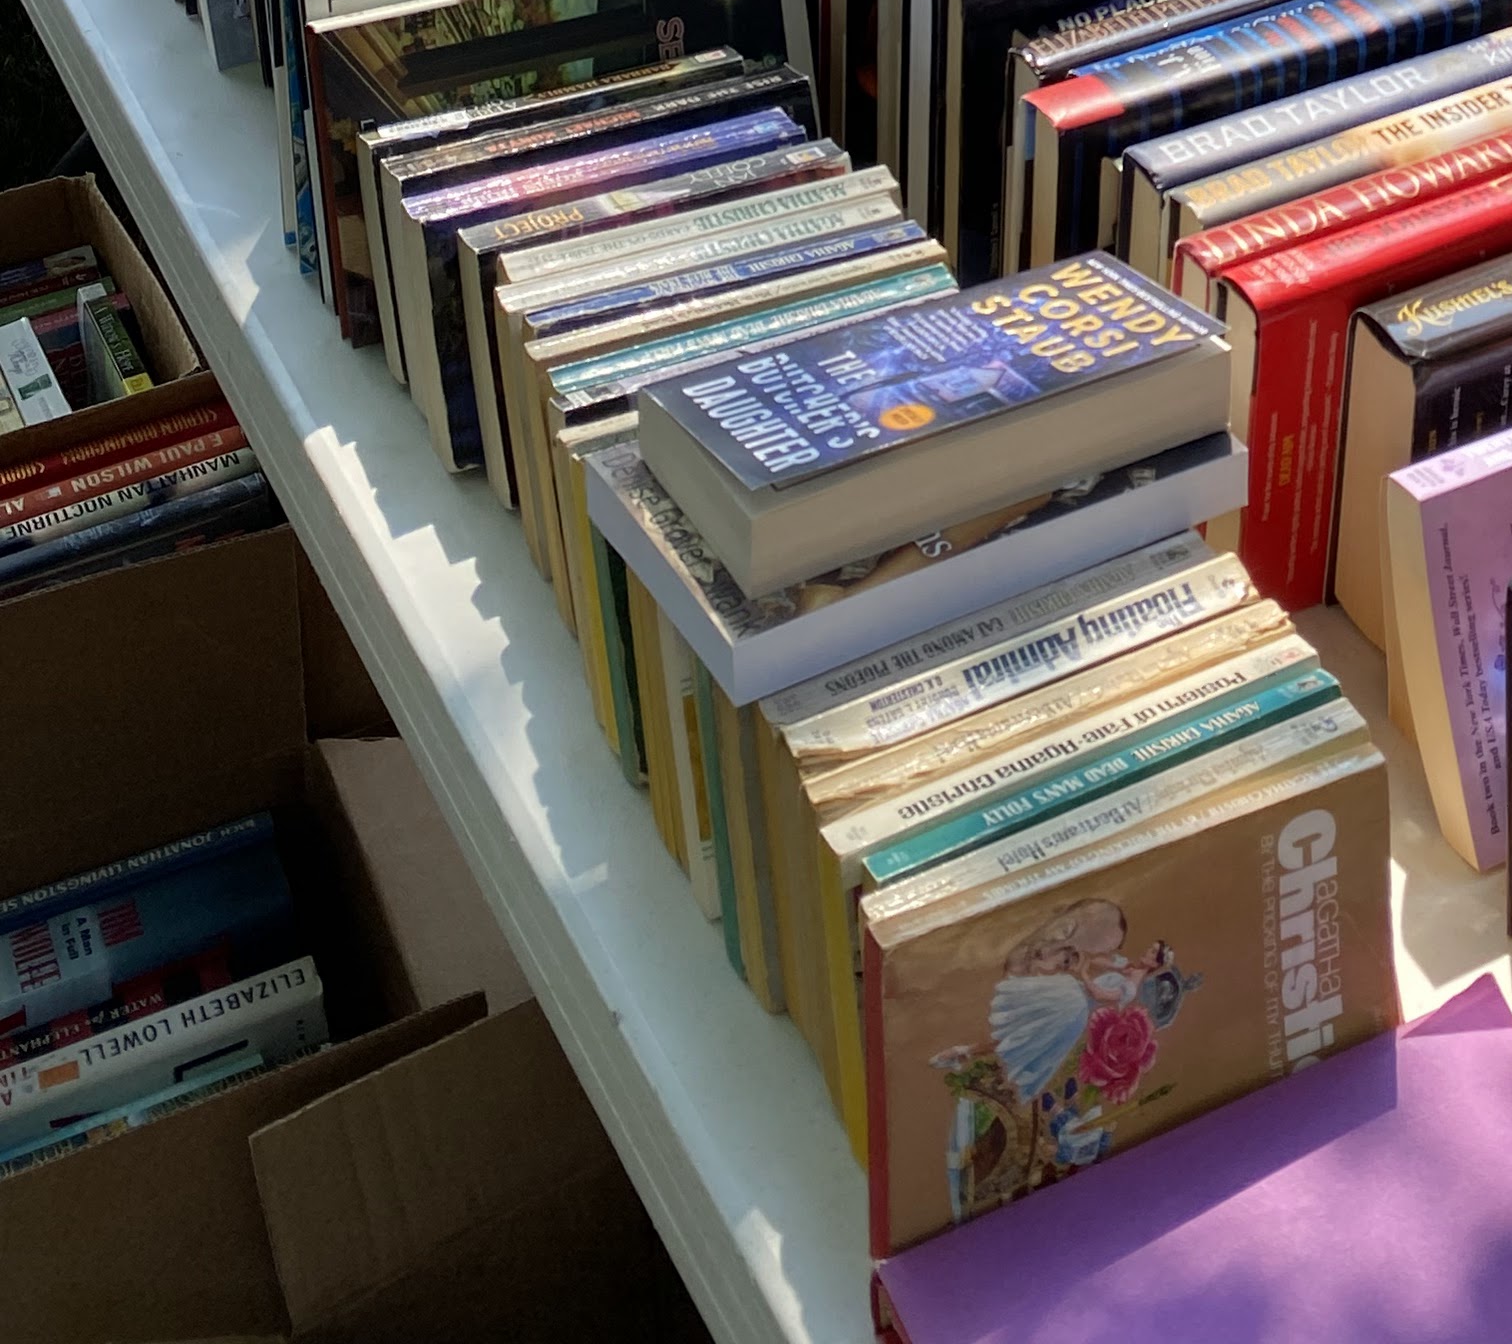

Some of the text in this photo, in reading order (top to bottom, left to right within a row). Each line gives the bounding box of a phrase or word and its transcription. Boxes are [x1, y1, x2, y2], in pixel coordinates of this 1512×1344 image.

[1057, 11, 1091, 32] NO
[1159, 66, 1431, 165] BRAD TAYLOR
[1184, 166, 1275, 210] BRAD
[1374, 120, 1423, 147] THE
[1422, 90, 1506, 131] INSIDER
[494, 205, 585, 239] PROJECT
[780, 181, 847, 210] AGATHA
[1200, 197, 1346, 265] LINDA
[970, 295, 1097, 375] STAUB
[1018, 283, 1142, 357] CORSI
[1050, 261, 1199, 348] WENDY
[818, 349, 878, 390] THE
[682, 375, 822, 475] DAUGHTER
[70, 437, 205, 494] PAUL WILSON
[116, 452, 240, 504] MANHATTAN
[1130, 721, 1201, 762] CHRISTIE
[1201, 698, 1261, 732] AGATHA
[896, 669, 1248, 824] Postern Christie
[1083, 755, 1129, 782] DEAD
[981, 796, 1032, 828] FOLLY
[22, 830, 213, 906] JONATHAN LIVINGSTON
[80, 967, 306, 1067] ELIZABETH LOWELL
